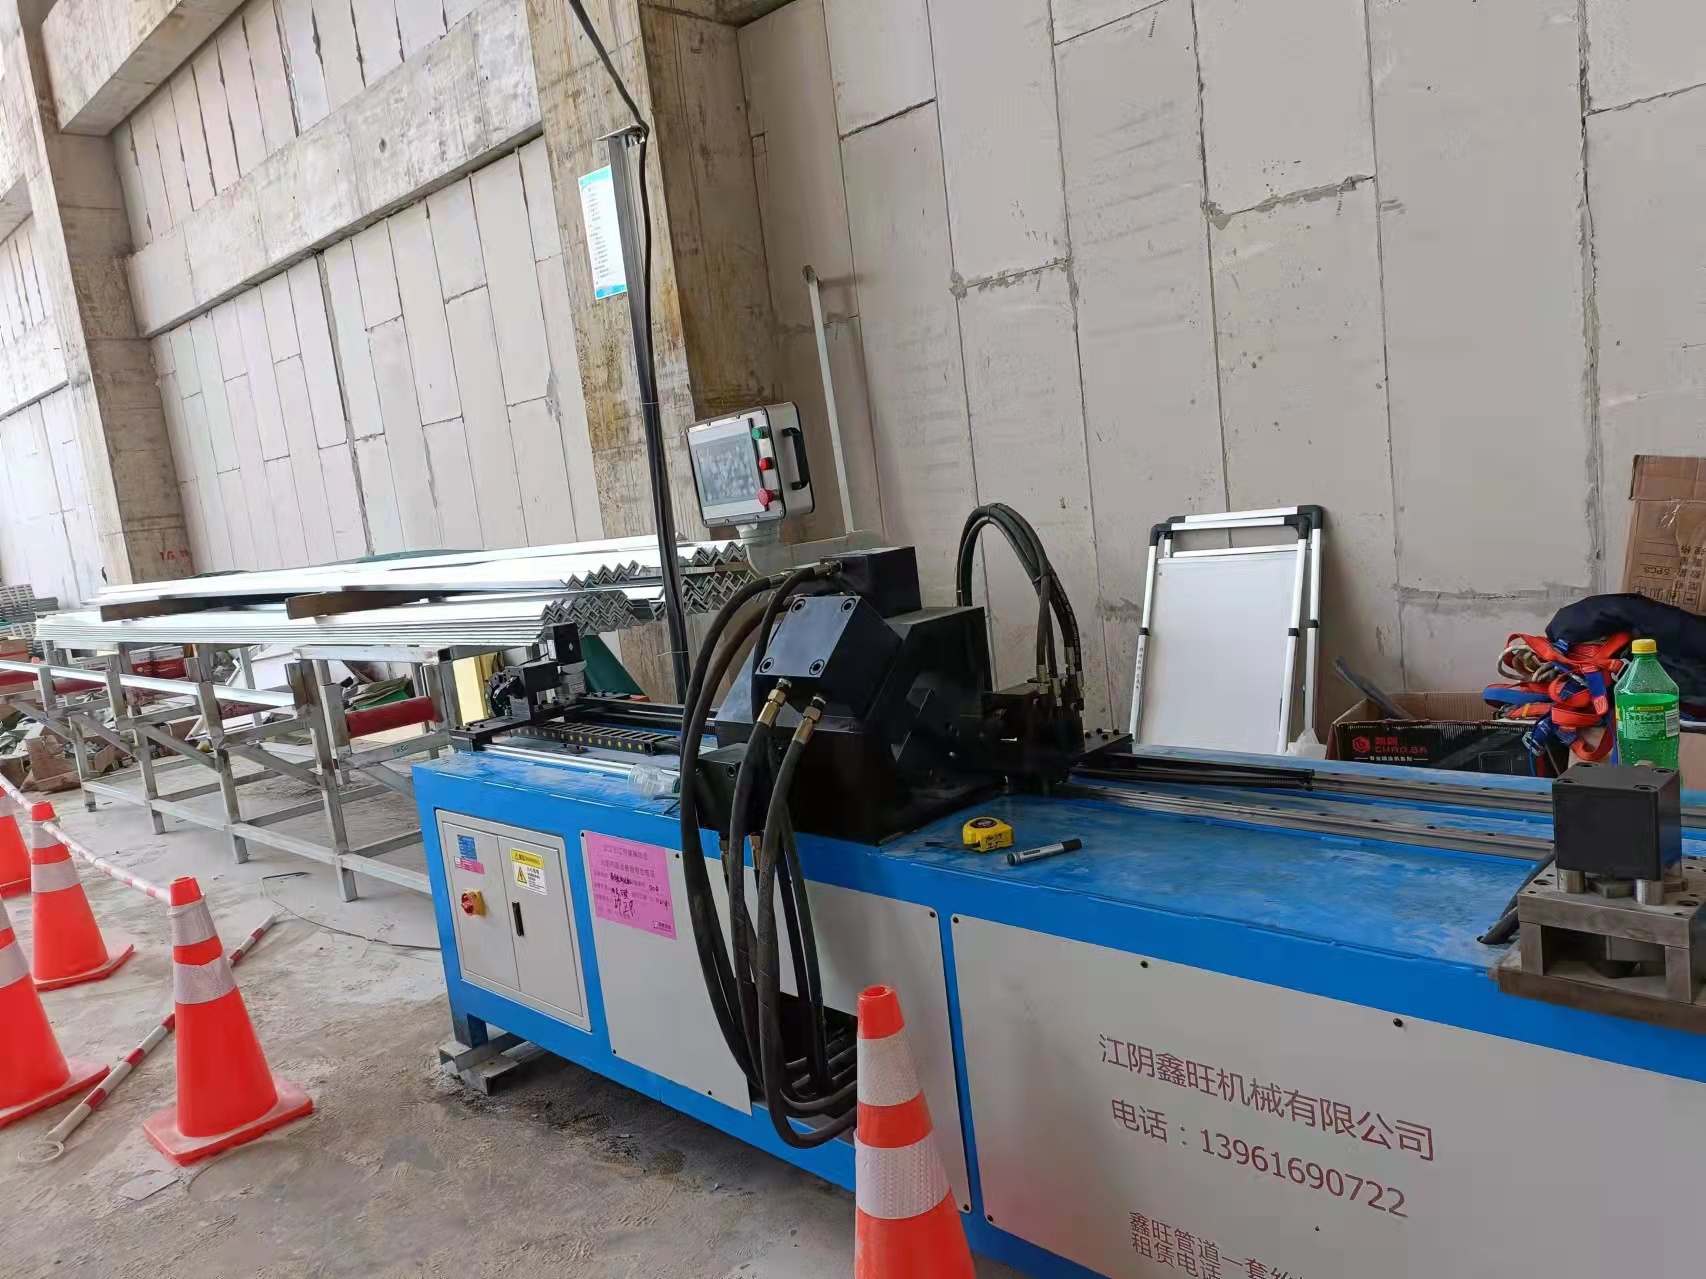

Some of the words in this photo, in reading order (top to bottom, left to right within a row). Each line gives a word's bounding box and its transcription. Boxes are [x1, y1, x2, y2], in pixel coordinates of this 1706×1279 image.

[1098, 1033, 1435, 1162] 江阴鑫旺机械有限公司
